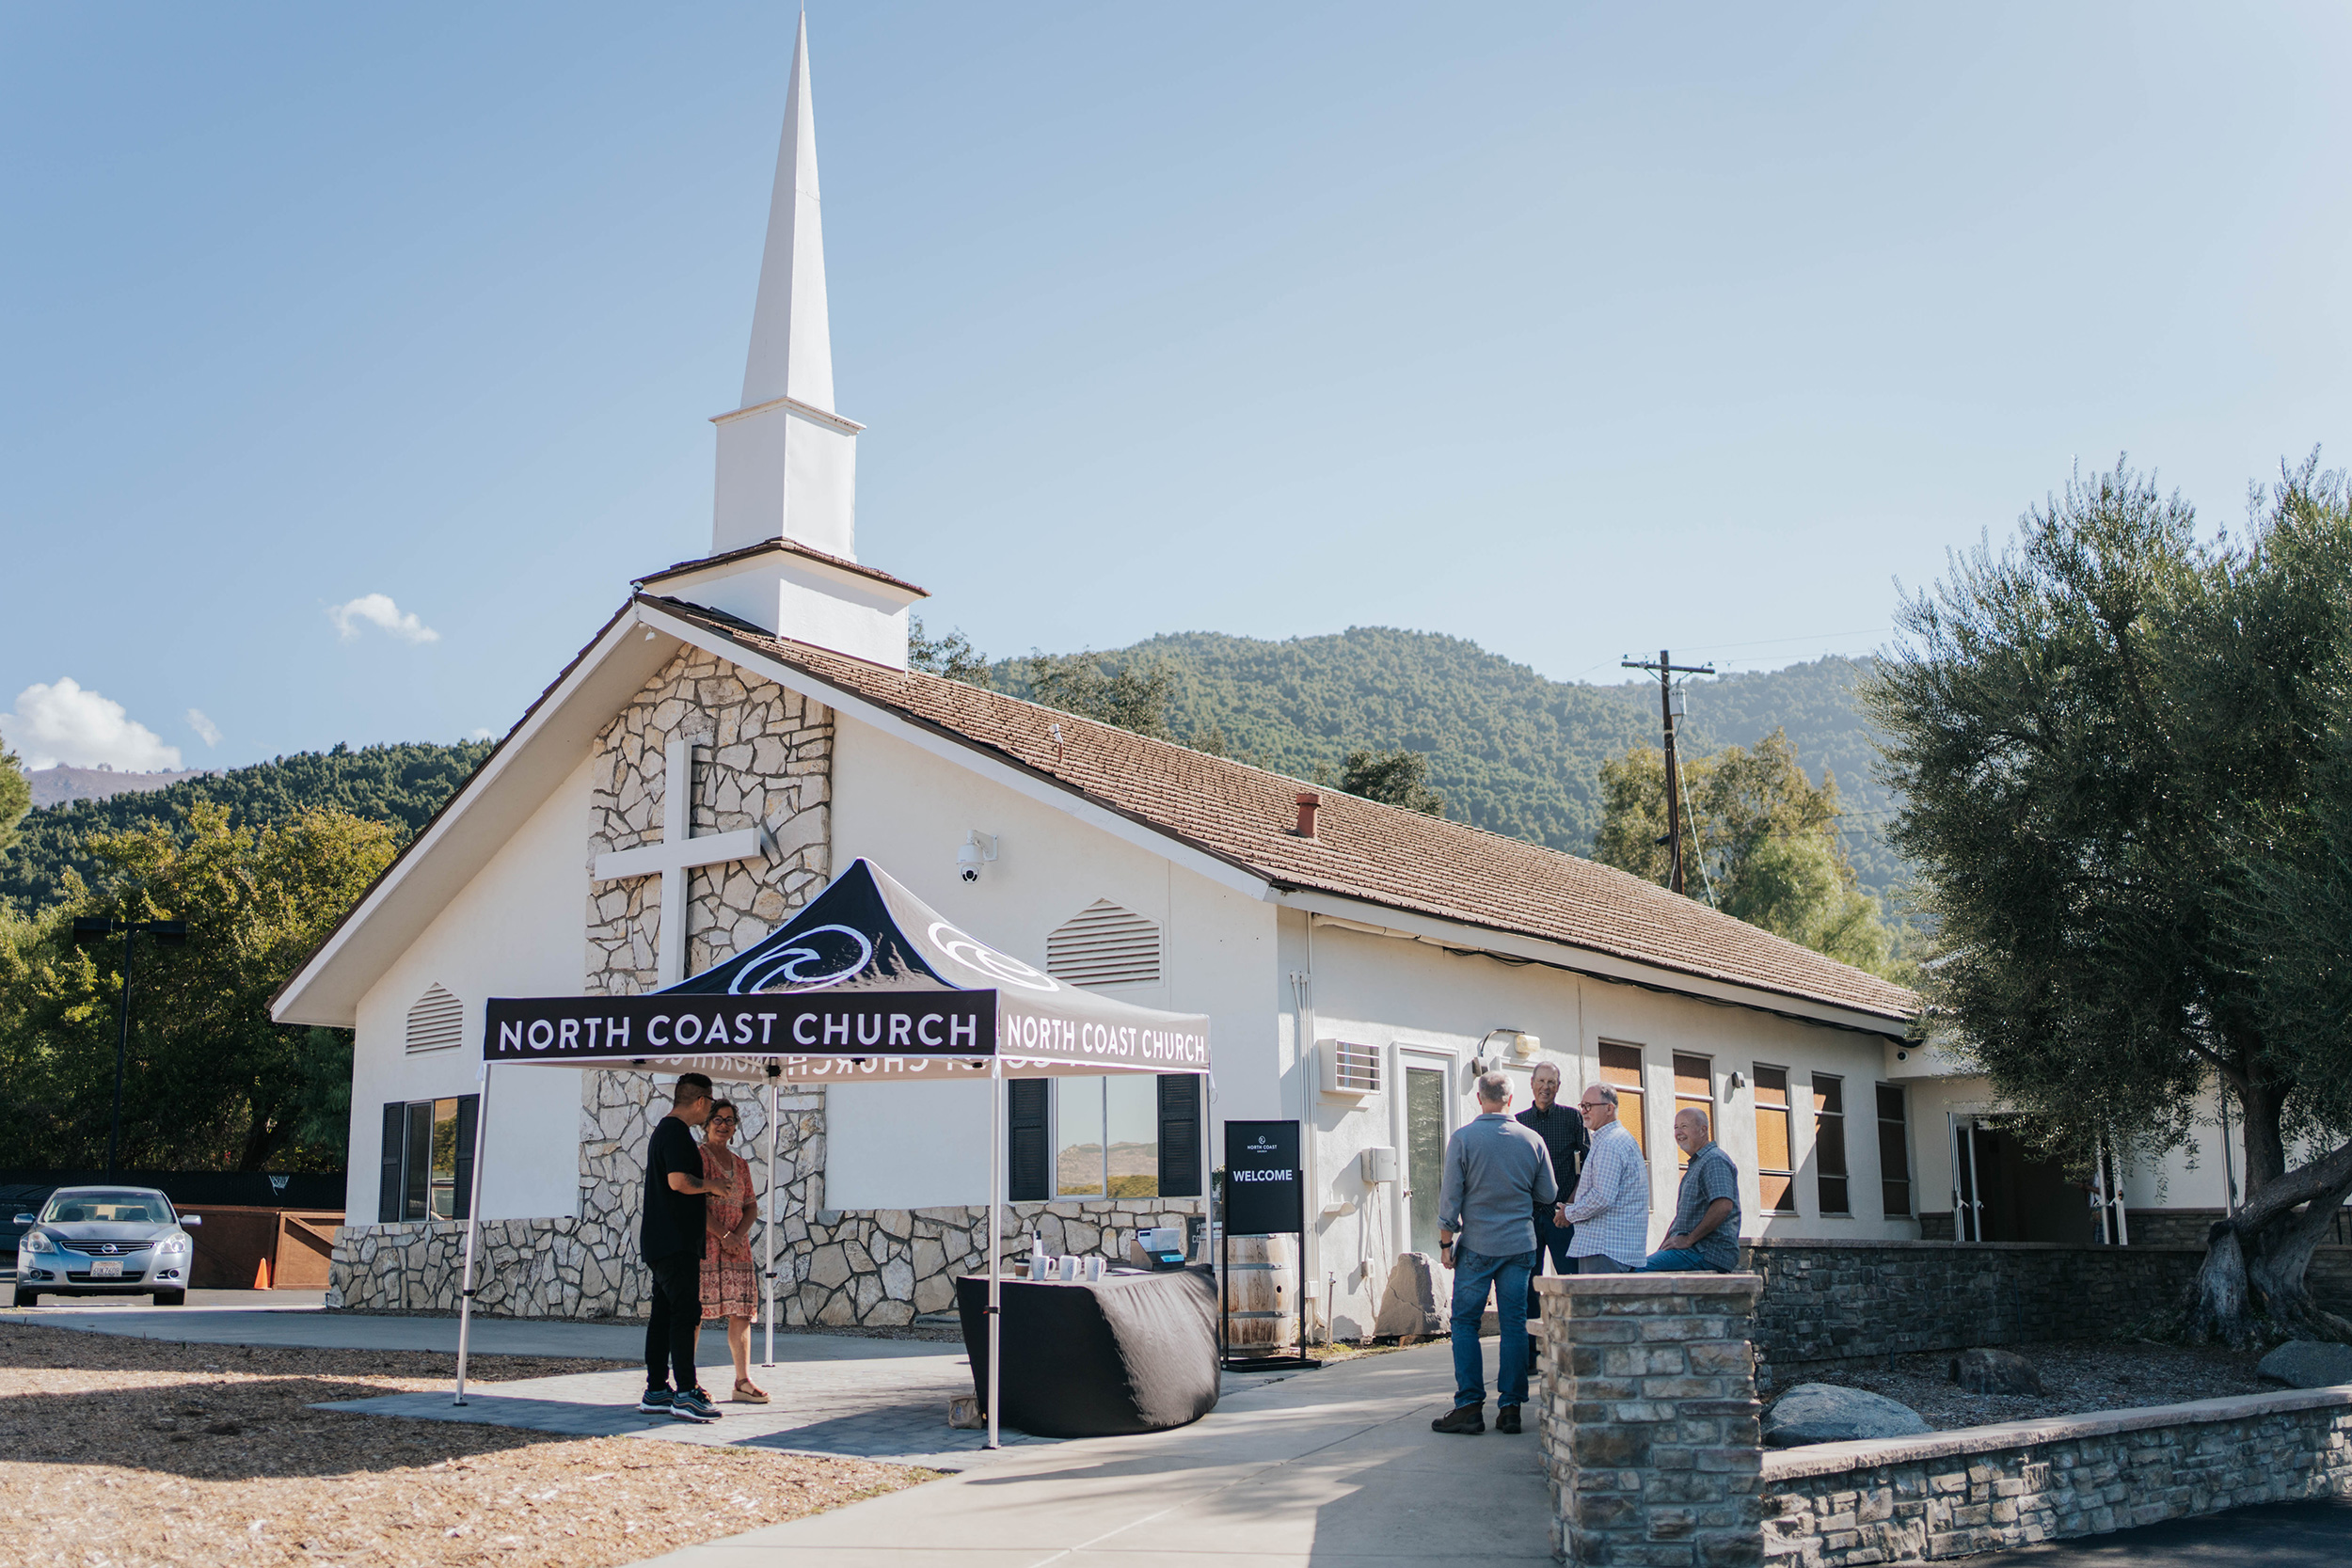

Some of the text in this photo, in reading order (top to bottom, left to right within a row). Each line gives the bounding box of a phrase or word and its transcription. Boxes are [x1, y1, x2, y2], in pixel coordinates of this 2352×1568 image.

[499, 1012, 977, 1052] NORTH COAST CHURCH
[1007, 1014, 1205, 1062] NORTH COAST CHURCH
[1232, 1169, 1293, 1182] WELCOME
